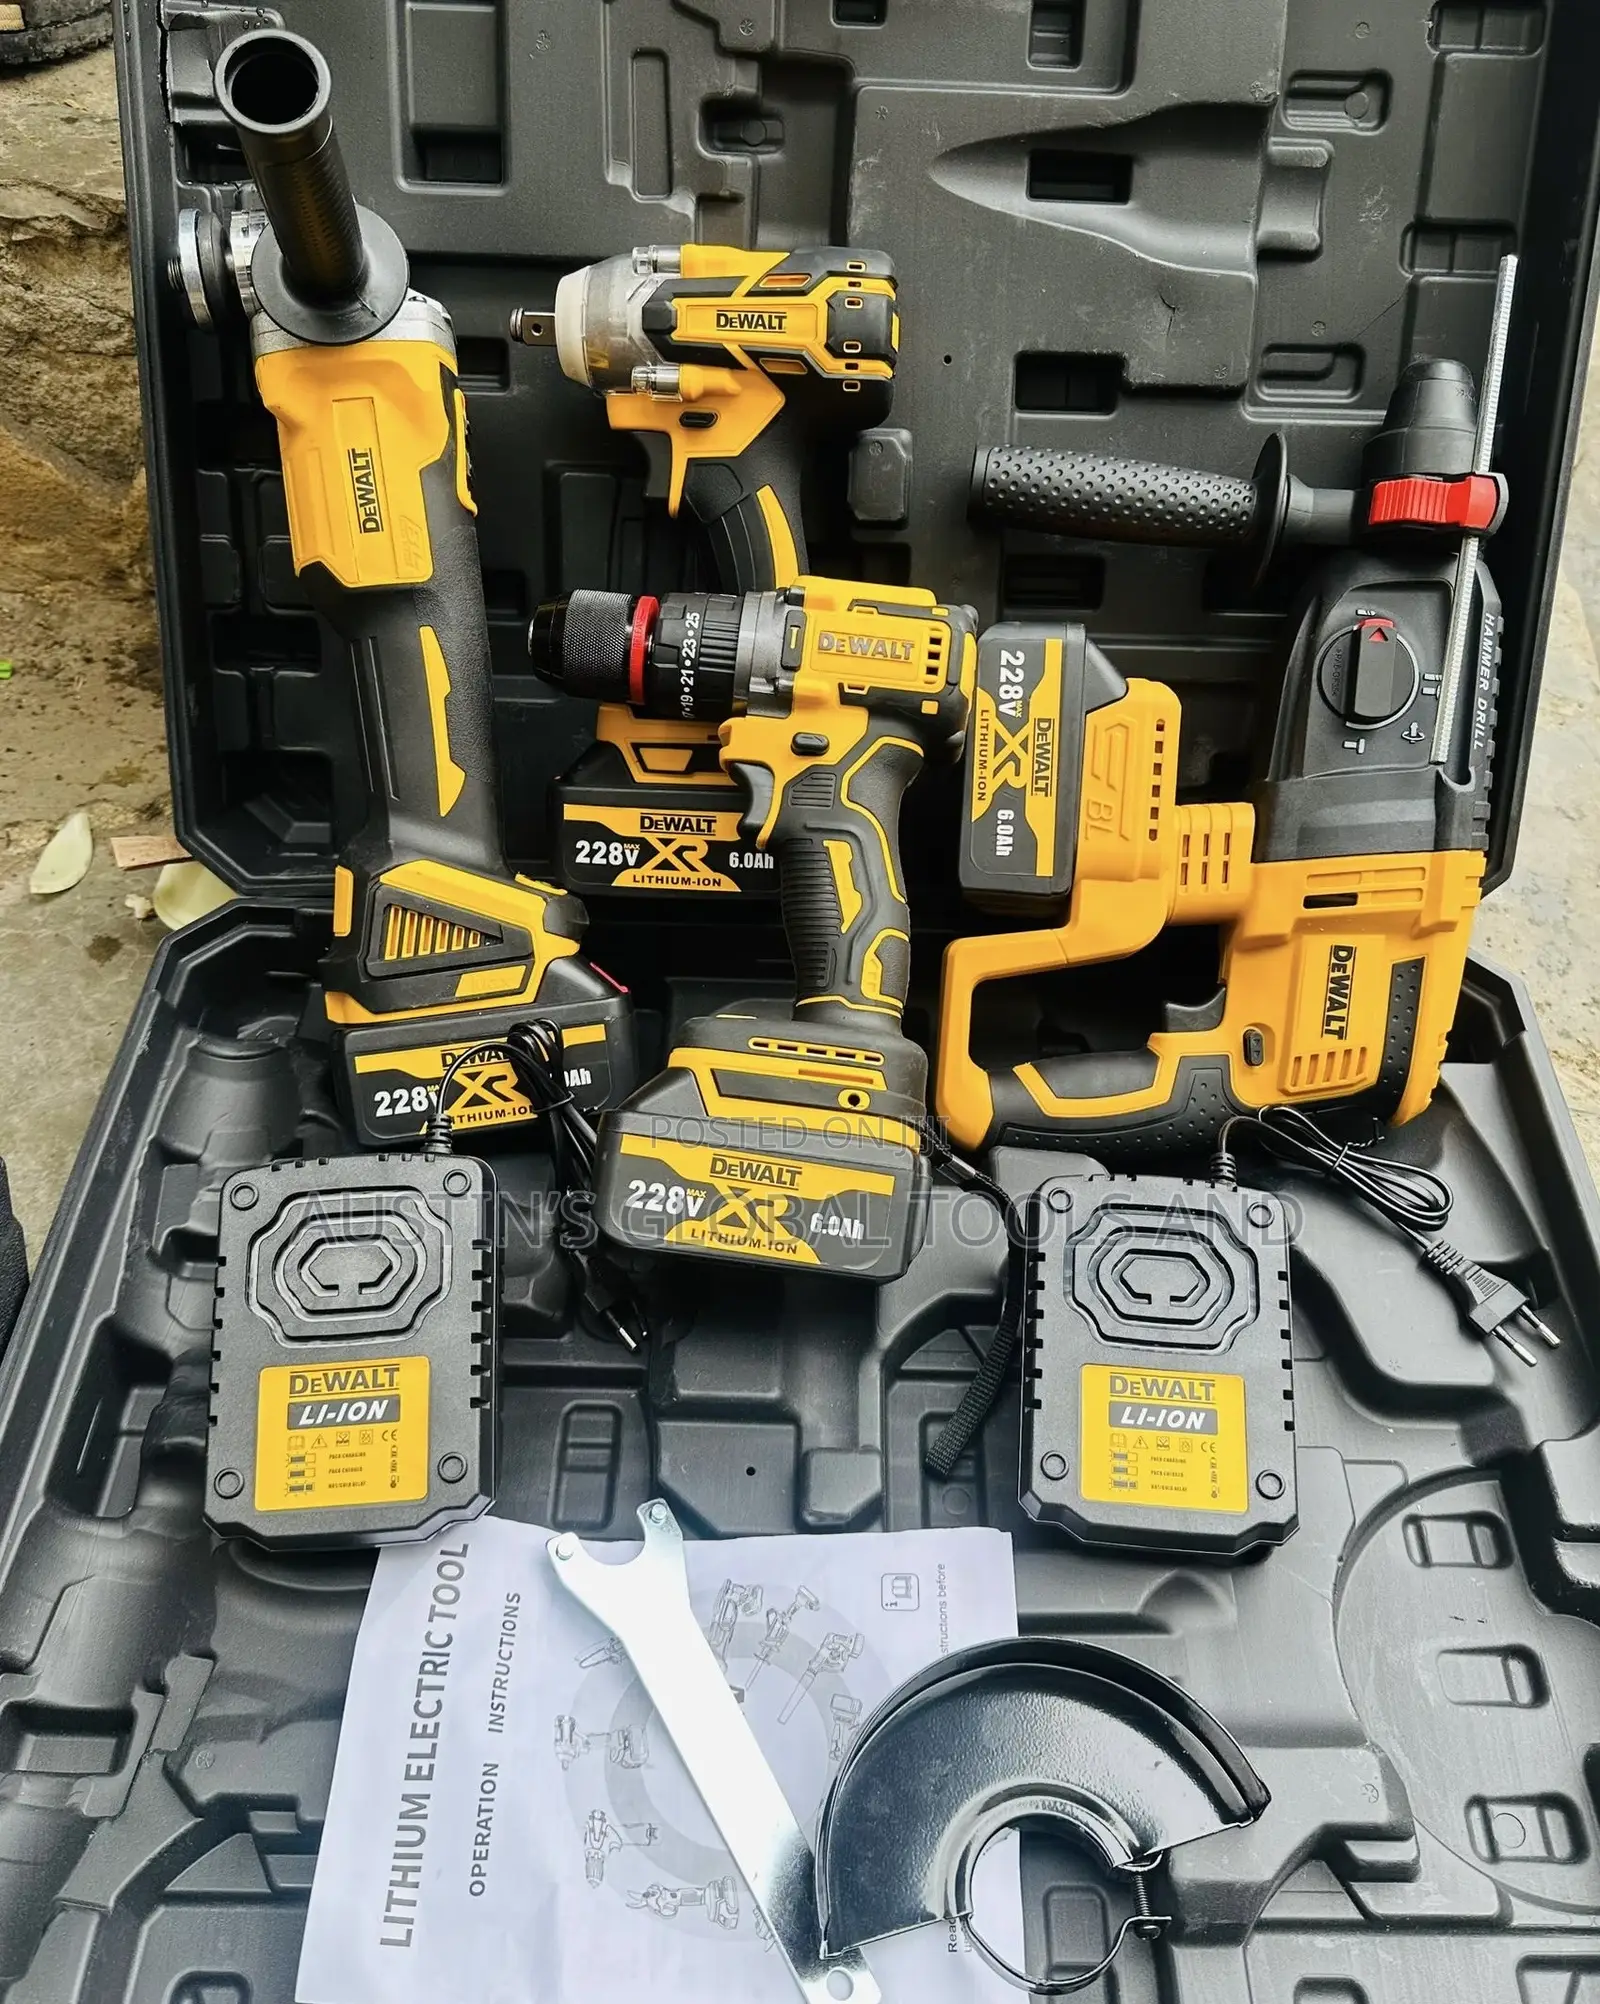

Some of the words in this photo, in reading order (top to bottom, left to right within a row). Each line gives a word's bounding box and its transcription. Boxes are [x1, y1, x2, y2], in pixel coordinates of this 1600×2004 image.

[716, 311, 787, 332] DEWALT
[349, 447, 382, 534] DEWALT
[685, 612, 700, 629] 25
[682, 638, 697, 659] 23
[818, 631, 915, 661] DEWALT
[1479, 612, 1495, 691] HAMMER
[680, 668, 695, 686] 21
[1473, 697, 1488, 750] DRILL
[977, 709, 989, 802] LITHIUM-ION
[1033, 718, 1053, 797] DEWALT
[640, 814, 717, 834] DEWALT
[995, 809, 1015, 857] 6.0Ah
[729, 852, 774, 870] 6.0Ah
[633, 874, 722, 888] LITHIUM-ION
[1323, 944, 1355, 1040] DEWALT
[710, 1154, 803, 1189] DEWALT
[690, 1227, 798, 1255] LITHIUM-ION
[810, 1212, 865, 1241] 6.0Ah
[289, 1366, 400, 1396] DEWALT
[1109, 1374, 1216, 1402] DEWALT
[299, 1399, 389, 1426] LI-ION
[1120, 1406, 1206, 1430] LI-ION
[427, 1543, 469, 1623] TOOL
[404, 1630, 453, 1781] ELECTRIC
[469, 1762, 499, 1897] OPERATION
[488, 1592, 521, 1733] INSTRUCTIONS
[379, 1793, 431, 1947] LITHIUM
